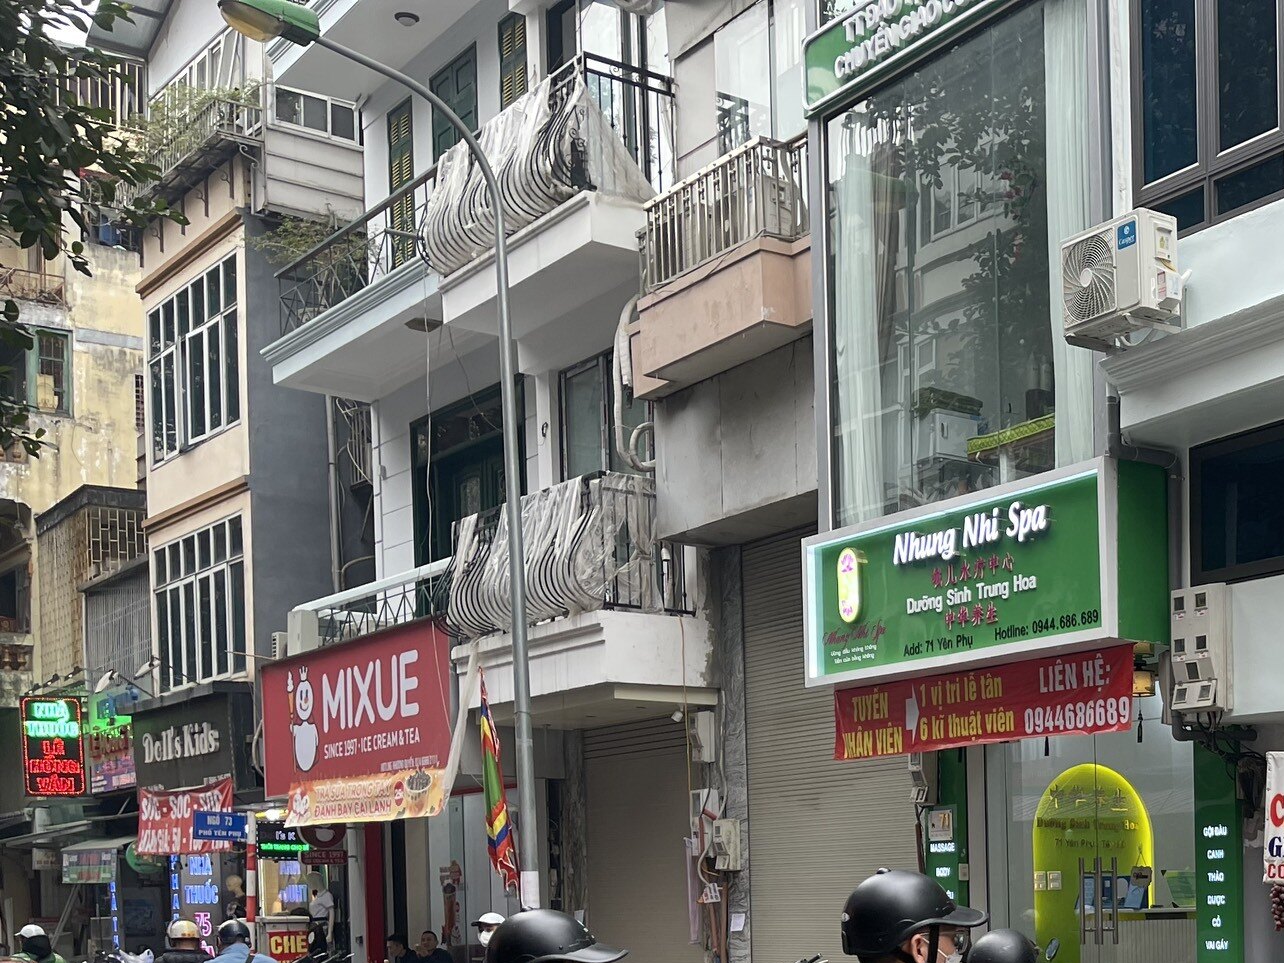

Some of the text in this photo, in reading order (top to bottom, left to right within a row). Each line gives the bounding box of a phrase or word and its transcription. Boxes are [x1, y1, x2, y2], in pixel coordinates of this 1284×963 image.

[894, 501, 1047, 565] Nhung Nhi Spa
[906, 574, 1036, 614] Dưỡng Sinh Trung Hoa
[904, 609, 1099, 657] Add: 71 Yên Phụ Hotline: 0944.686.689
[322, 649, 420, 734] MIXUE
[1039, 659, 1077, 693] LIÊN
[985, 706, 1015, 733] viên
[1024, 696, 1130, 735] 0944686689
[324, 744, 343, 760] SINCE
[373, 732, 398, 751] CREAM
[404, 727, 420, 744] TEA
[875, 722, 903, 755] VIÊN
[224, 816, 233, 826] 73
